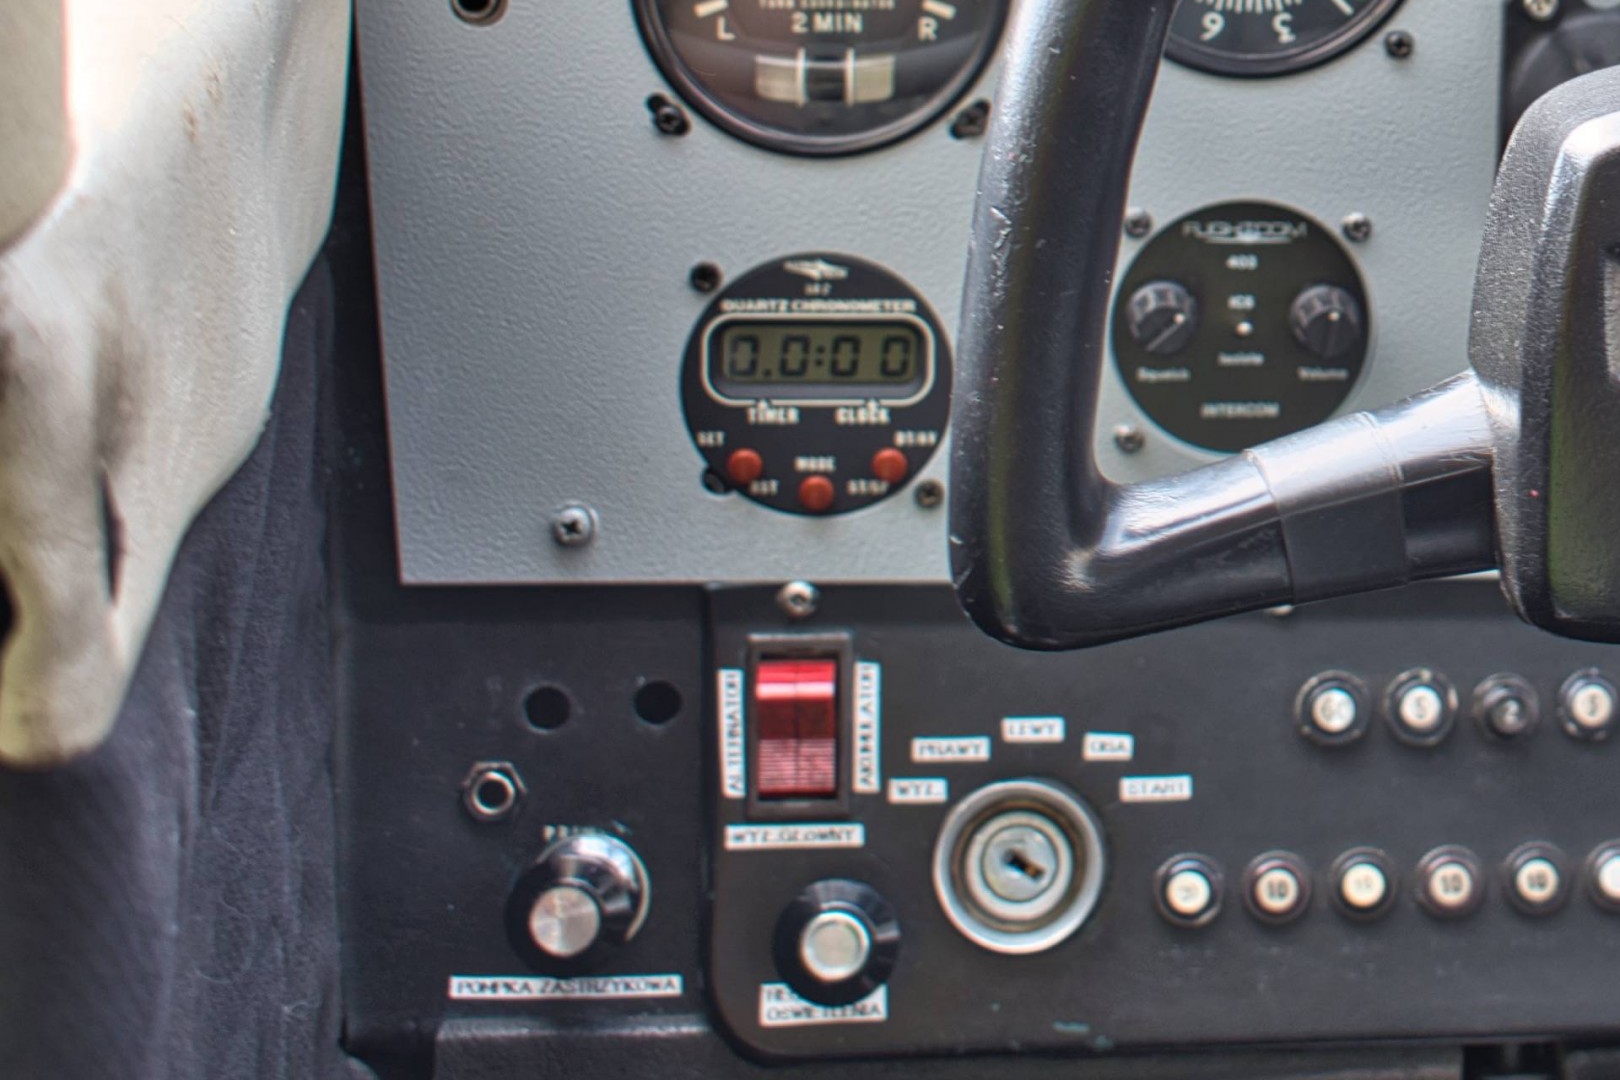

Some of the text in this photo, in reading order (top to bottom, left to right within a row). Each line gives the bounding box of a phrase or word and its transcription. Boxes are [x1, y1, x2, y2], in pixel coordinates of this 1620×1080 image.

[716, 18, 736, 41] L
[791, 14, 863, 34] 2 MIN
[917, 17, 938, 41] R
[719, 298, 917, 313] QUARTZ CHRONOMETER
[747, 407, 800, 425] TIMER
[834, 407, 890, 425] CLOCK
[1202, 402, 1279, 418] INTERCOM
[455, 976, 679, 996] POMPKA ZASTRZYKOWA
